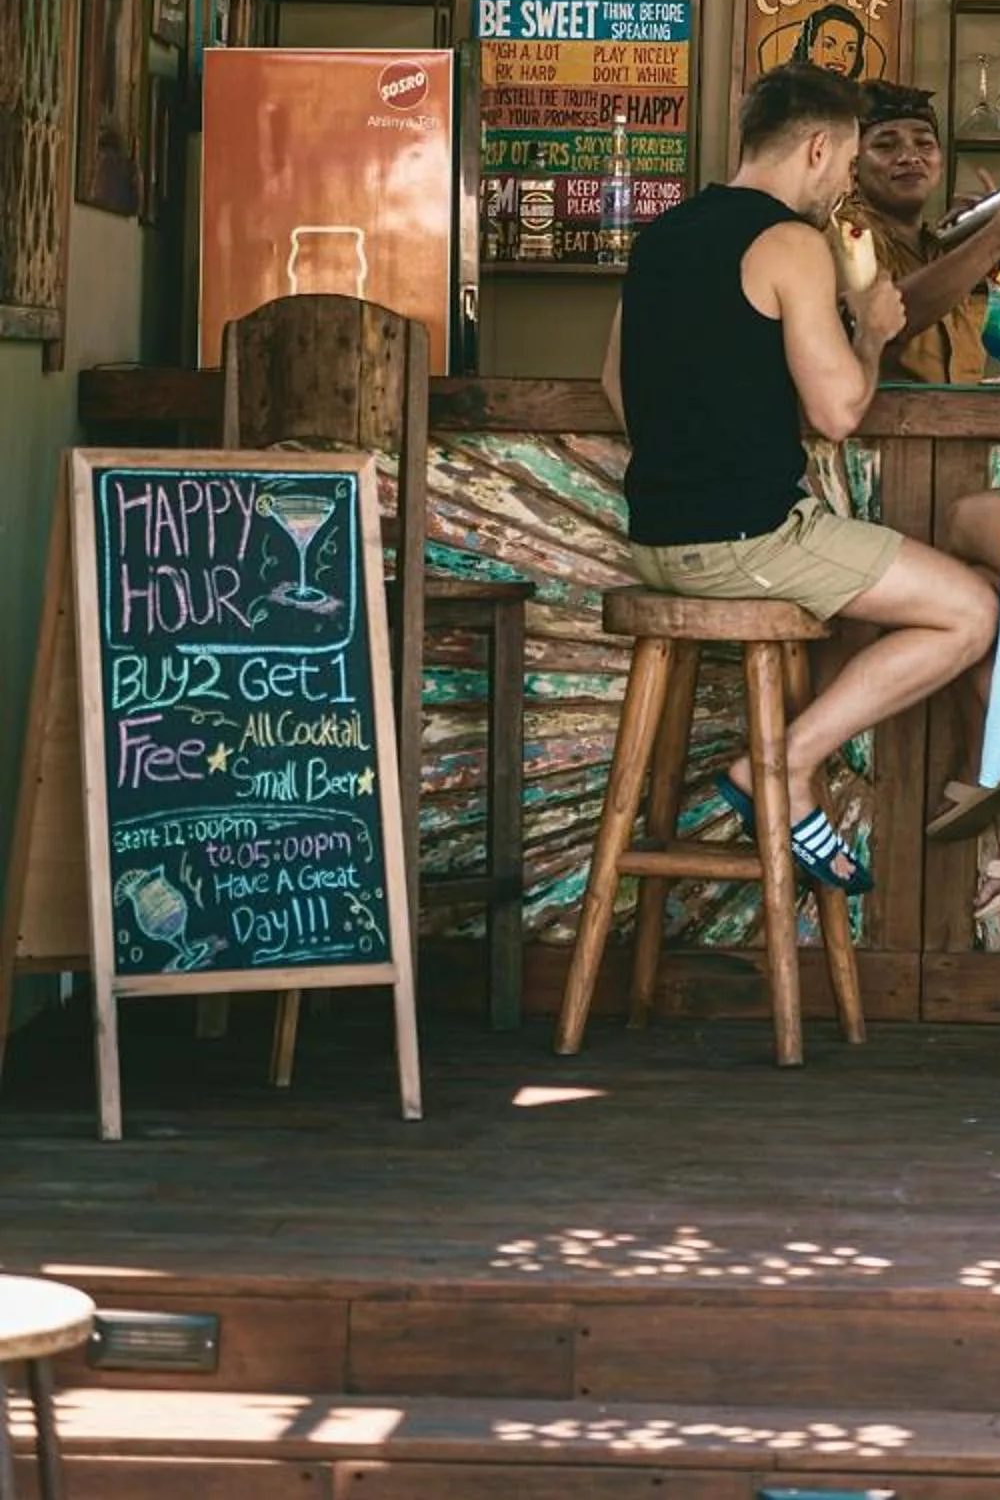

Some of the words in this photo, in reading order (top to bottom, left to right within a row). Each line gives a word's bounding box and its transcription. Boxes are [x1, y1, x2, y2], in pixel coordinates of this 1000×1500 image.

[479, 0, 511, 38] BE
[521, 1, 599, 39] SWEET
[603, 1, 636, 21] THINK
[639, 2, 685, 23] BEFORE
[611, 22, 671, 41] SPEAKING
[520, 44, 531, 61] A
[536, 43, 561, 61] LOT
[593, 46, 627, 64] PLAY
[633, 46, 679, 64] NICELY
[520, 65, 556, 82] HARD
[637, 66, 678, 84] WHINE
[381, 72, 425, 100] SOSRO
[563, 89, 599, 107] TRUTH
[509, 108, 538, 126] YOUR
[543, 110, 599, 127] PROMISES
[600, 93, 622, 123] BE
[627, 95, 684, 127] HAPPY
[631, 137, 684, 156] PRAYERS
[571, 156, 601, 172] LOVE
[566, 179, 599, 197] KEEP
[633, 181, 681, 199] FRIENDS
[566, 198, 601, 215] PLEAS
[564, 231, 593, 252] EAT
[115, 478, 256, 560] HAPPY
[121, 564, 251, 635] HOUR
[238, 657, 328, 702] Get
[329, 652, 356, 703] 1
[117, 713, 205, 789] Free
[238, 711, 274, 752] All
[277, 708, 371, 751] Cocktail
[231, 757, 300, 801] Small
[306, 757, 359, 803] Beer
[164, 818, 258, 846] 12:00pm
[213, 874, 269, 905] Have
[276, 868, 294, 895] A
[299, 864, 361, 889] Great
[231, 897, 332, 950] Day!!!
